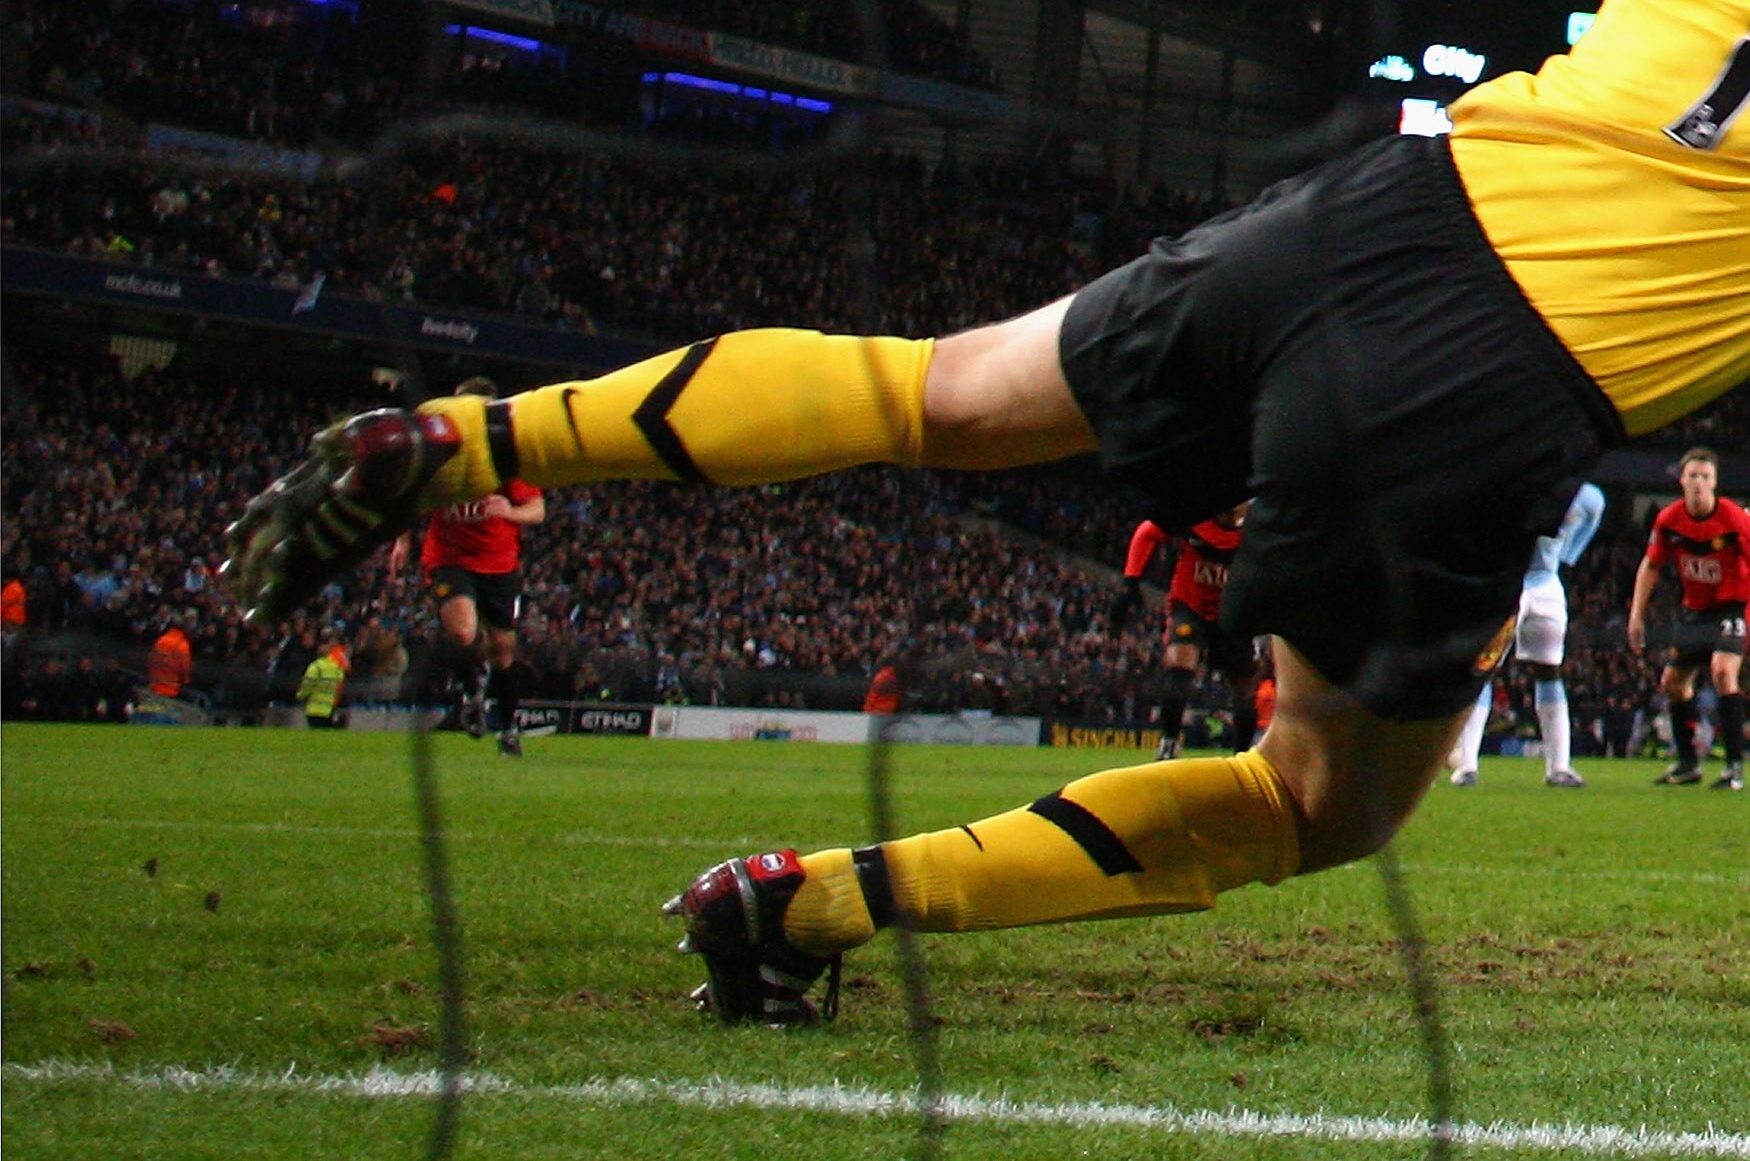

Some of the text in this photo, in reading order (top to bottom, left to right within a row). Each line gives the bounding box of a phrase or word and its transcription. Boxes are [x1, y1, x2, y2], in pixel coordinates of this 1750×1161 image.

[1721, 617, 1746, 638] 23
[512, 709, 560, 727] TIHAD
[581, 710, 642, 730] ETIHAD
[1071, 726, 1137, 749] SINGHA
